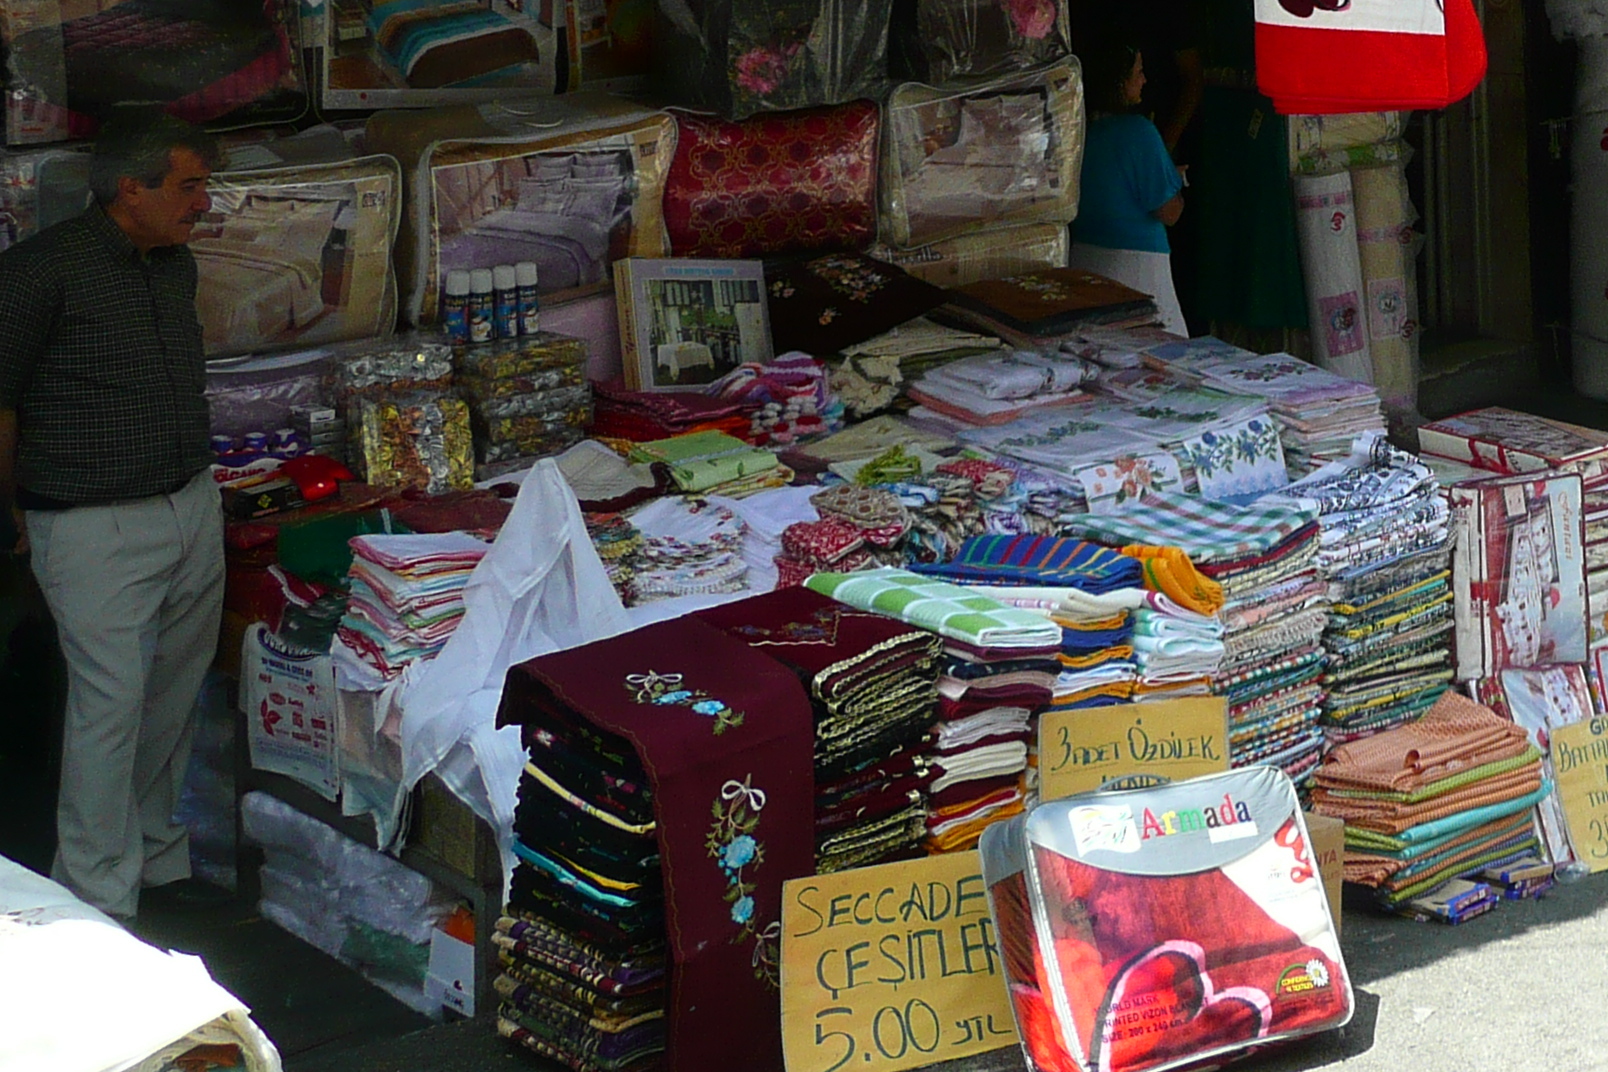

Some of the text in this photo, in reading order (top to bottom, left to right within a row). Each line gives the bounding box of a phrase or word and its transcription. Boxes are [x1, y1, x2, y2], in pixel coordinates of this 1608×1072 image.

[1126, 718, 1221, 762] ÖZDİLEK
[1141, 793, 1253, 840] Armada
[794, 874, 987, 938] SECCADE
[815, 998, 940, 1072] 5.00
